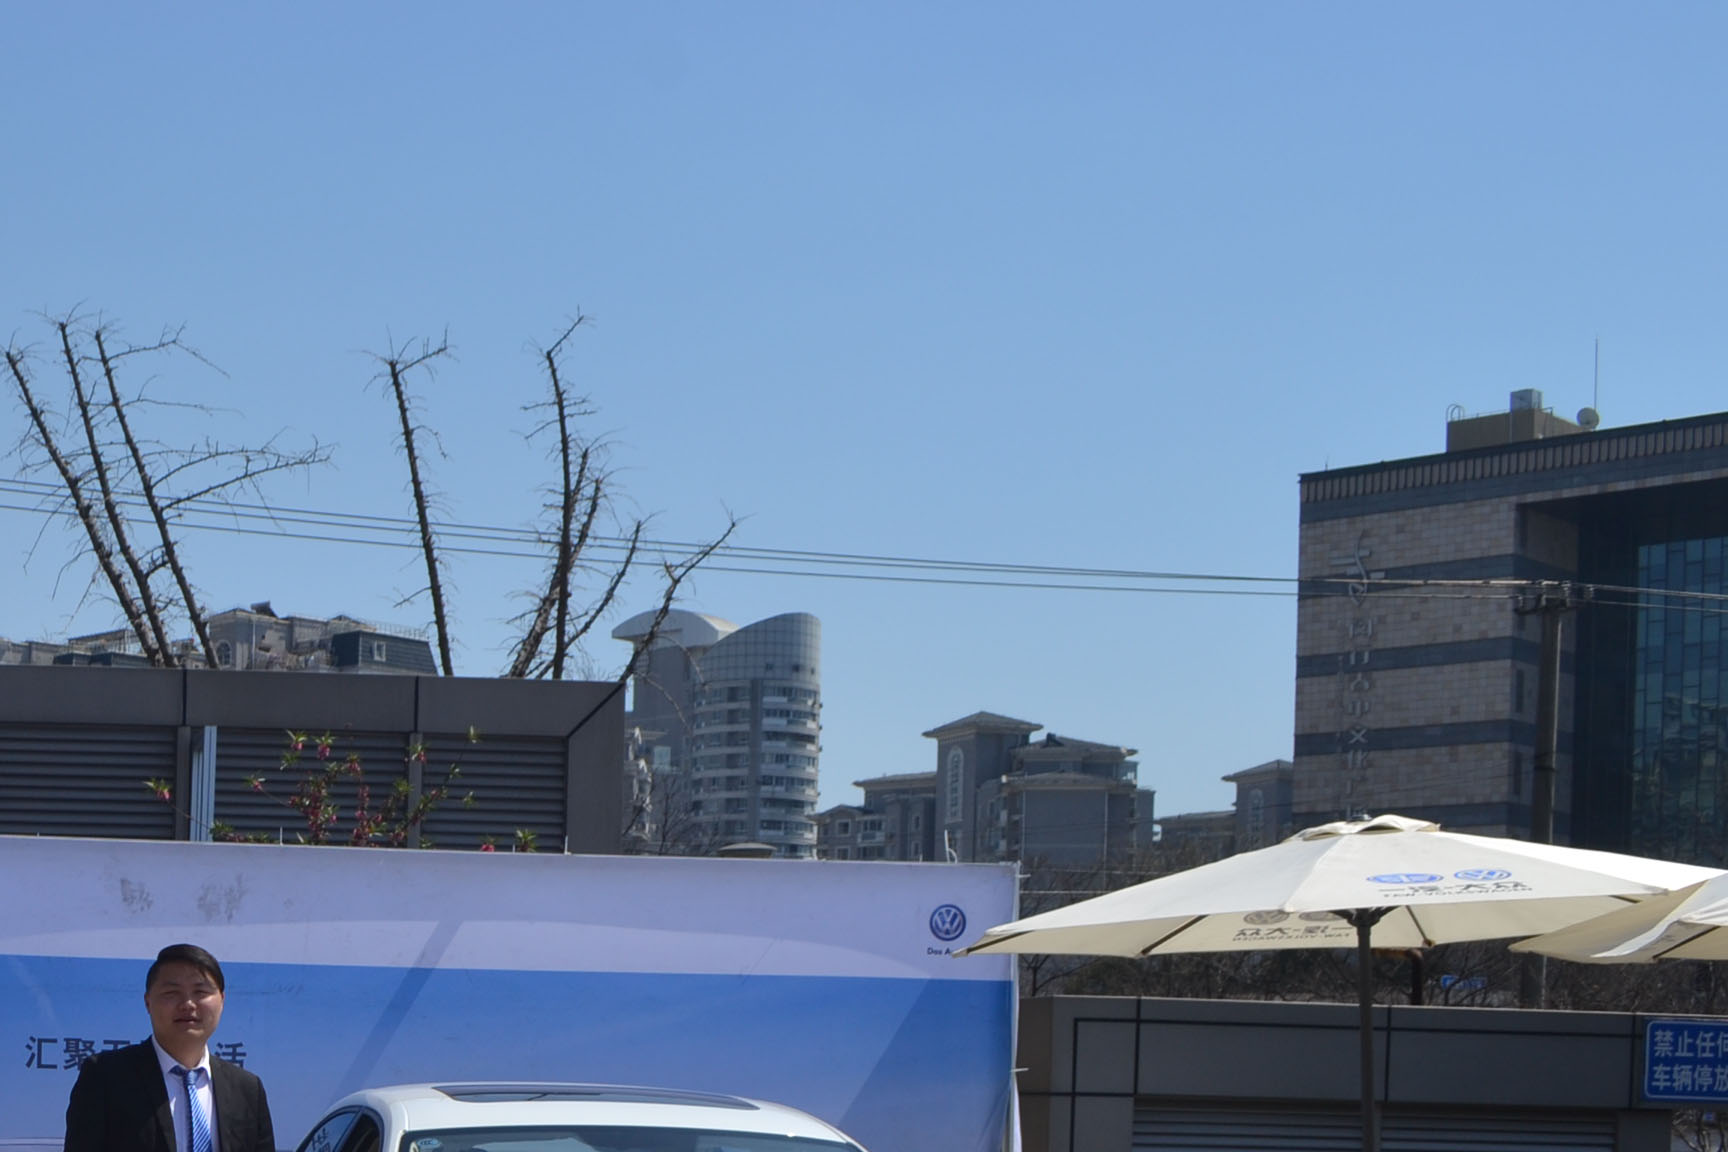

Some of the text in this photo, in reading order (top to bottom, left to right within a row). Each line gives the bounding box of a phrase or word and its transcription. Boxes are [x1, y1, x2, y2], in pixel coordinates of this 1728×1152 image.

[1654, 1030, 1728, 1058] 禁止任何
[1652, 1063, 1728, 1092] 车辆停放
